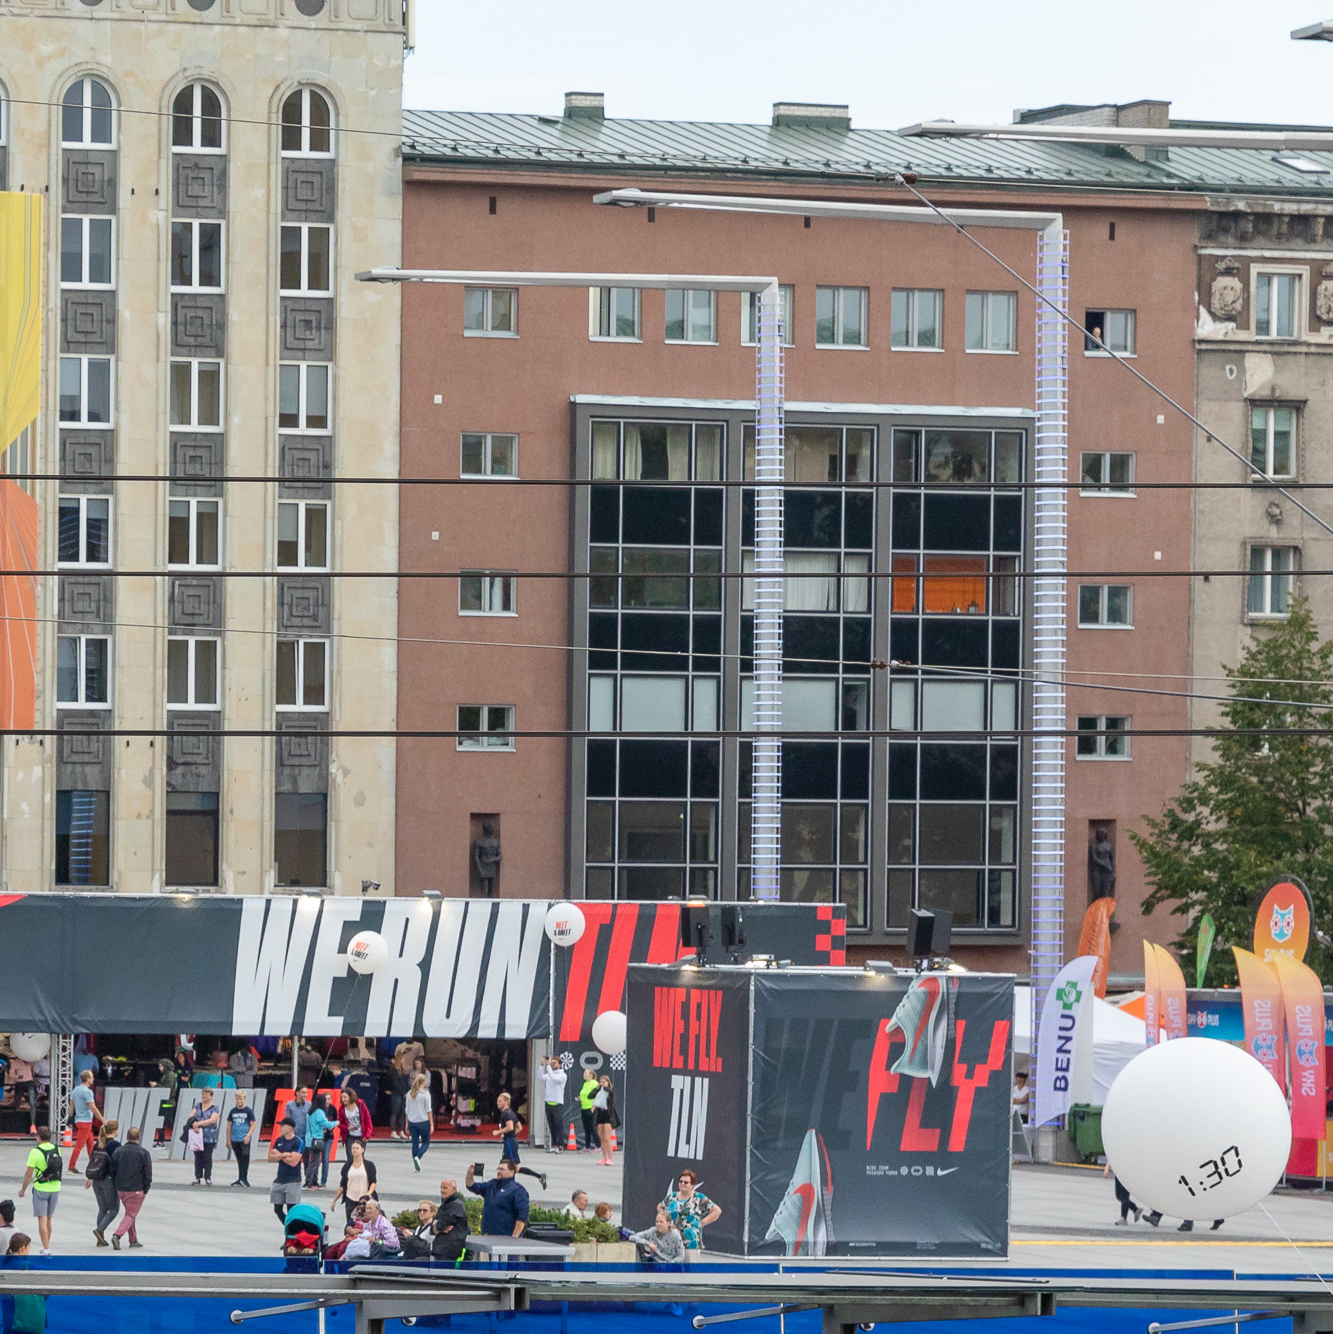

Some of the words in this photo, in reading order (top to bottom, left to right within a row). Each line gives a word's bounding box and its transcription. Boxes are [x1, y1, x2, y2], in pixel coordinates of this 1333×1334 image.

[232, 898, 365, 1038] WE
[363, 900, 548, 1040] RUN
[653, 986, 686, 1070] WE
[687, 988, 723, 1073] FLY.
[1054, 1014, 1076, 1092] BENU
[667, 1074, 709, 1161] TLN
[867, 1018, 1011, 1151] FLY
[1178, 1145, 1243, 1197] 1:30
